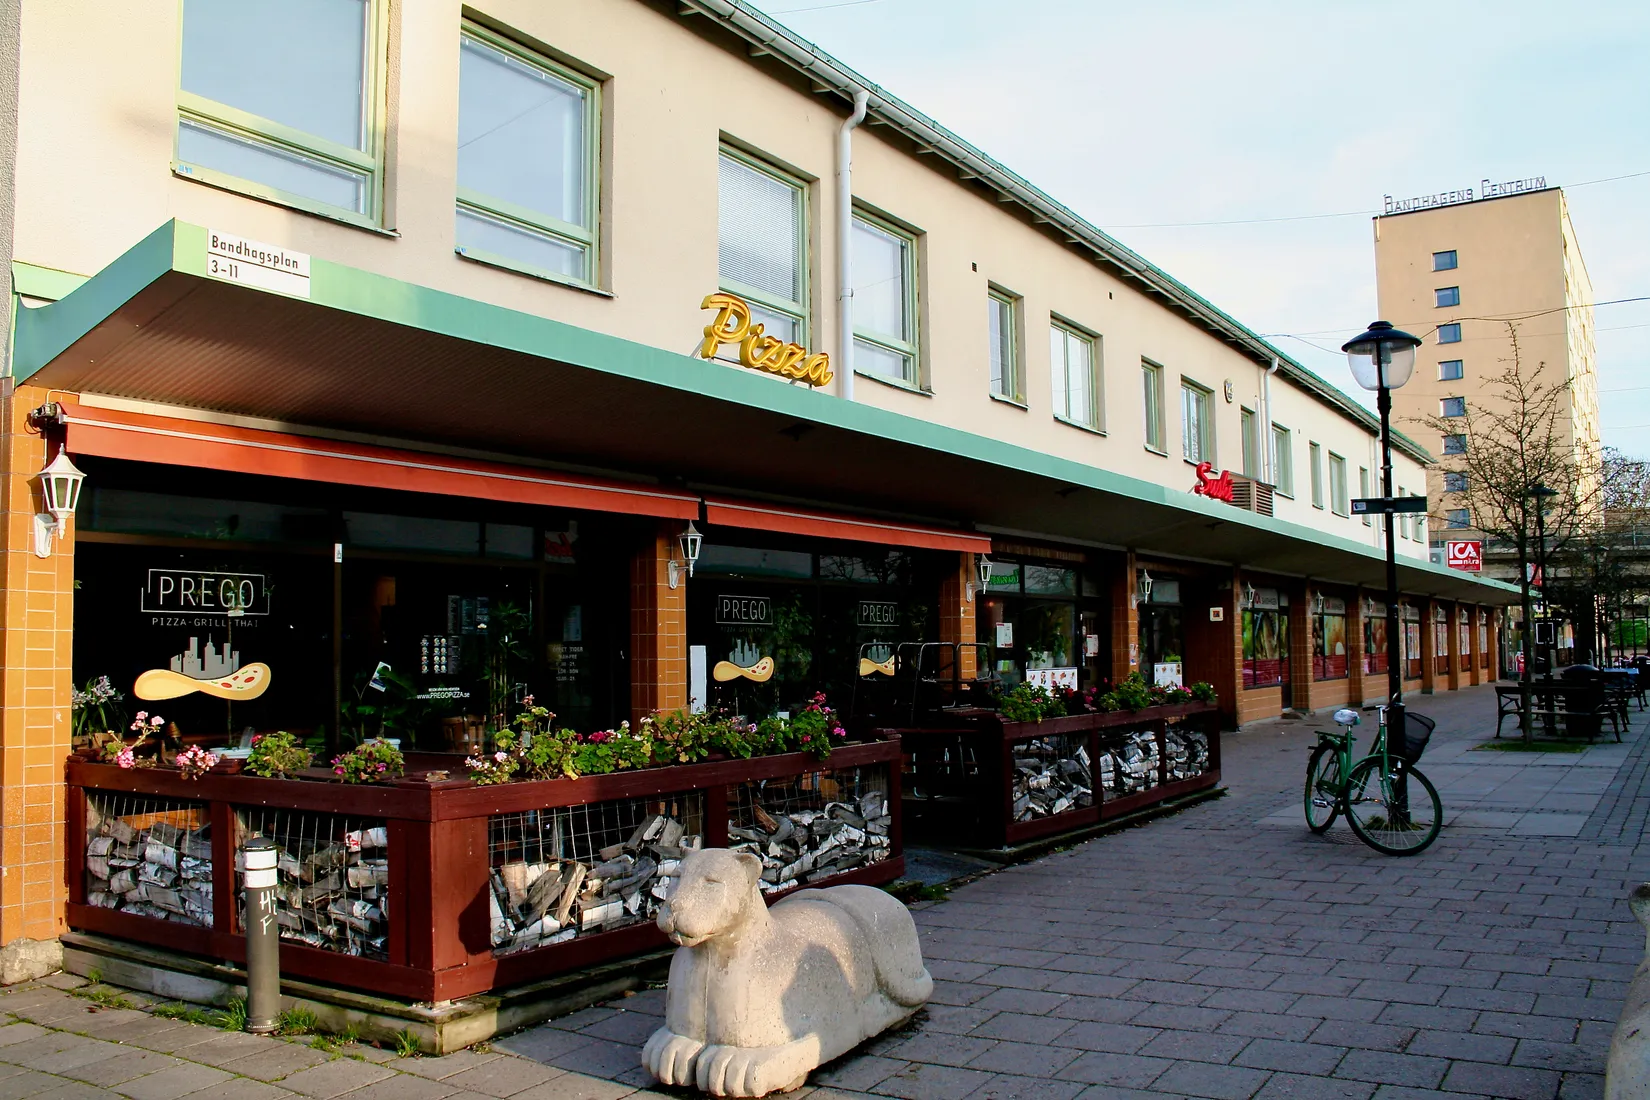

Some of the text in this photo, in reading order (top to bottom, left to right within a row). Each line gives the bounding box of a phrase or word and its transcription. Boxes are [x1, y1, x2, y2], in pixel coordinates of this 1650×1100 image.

[1481, 176, 1547, 199] CENTRUM
[211, 235, 298, 269] Bandhagsplan
[211, 260, 239, 278] 3-11
[700, 293, 833, 387] Pizza
[1448, 543, 1478, 559] ICA
[160, 576, 254, 608] PREGO
[723, 599, 766, 620] PREGO
[862, 604, 895, 622] PREGO
